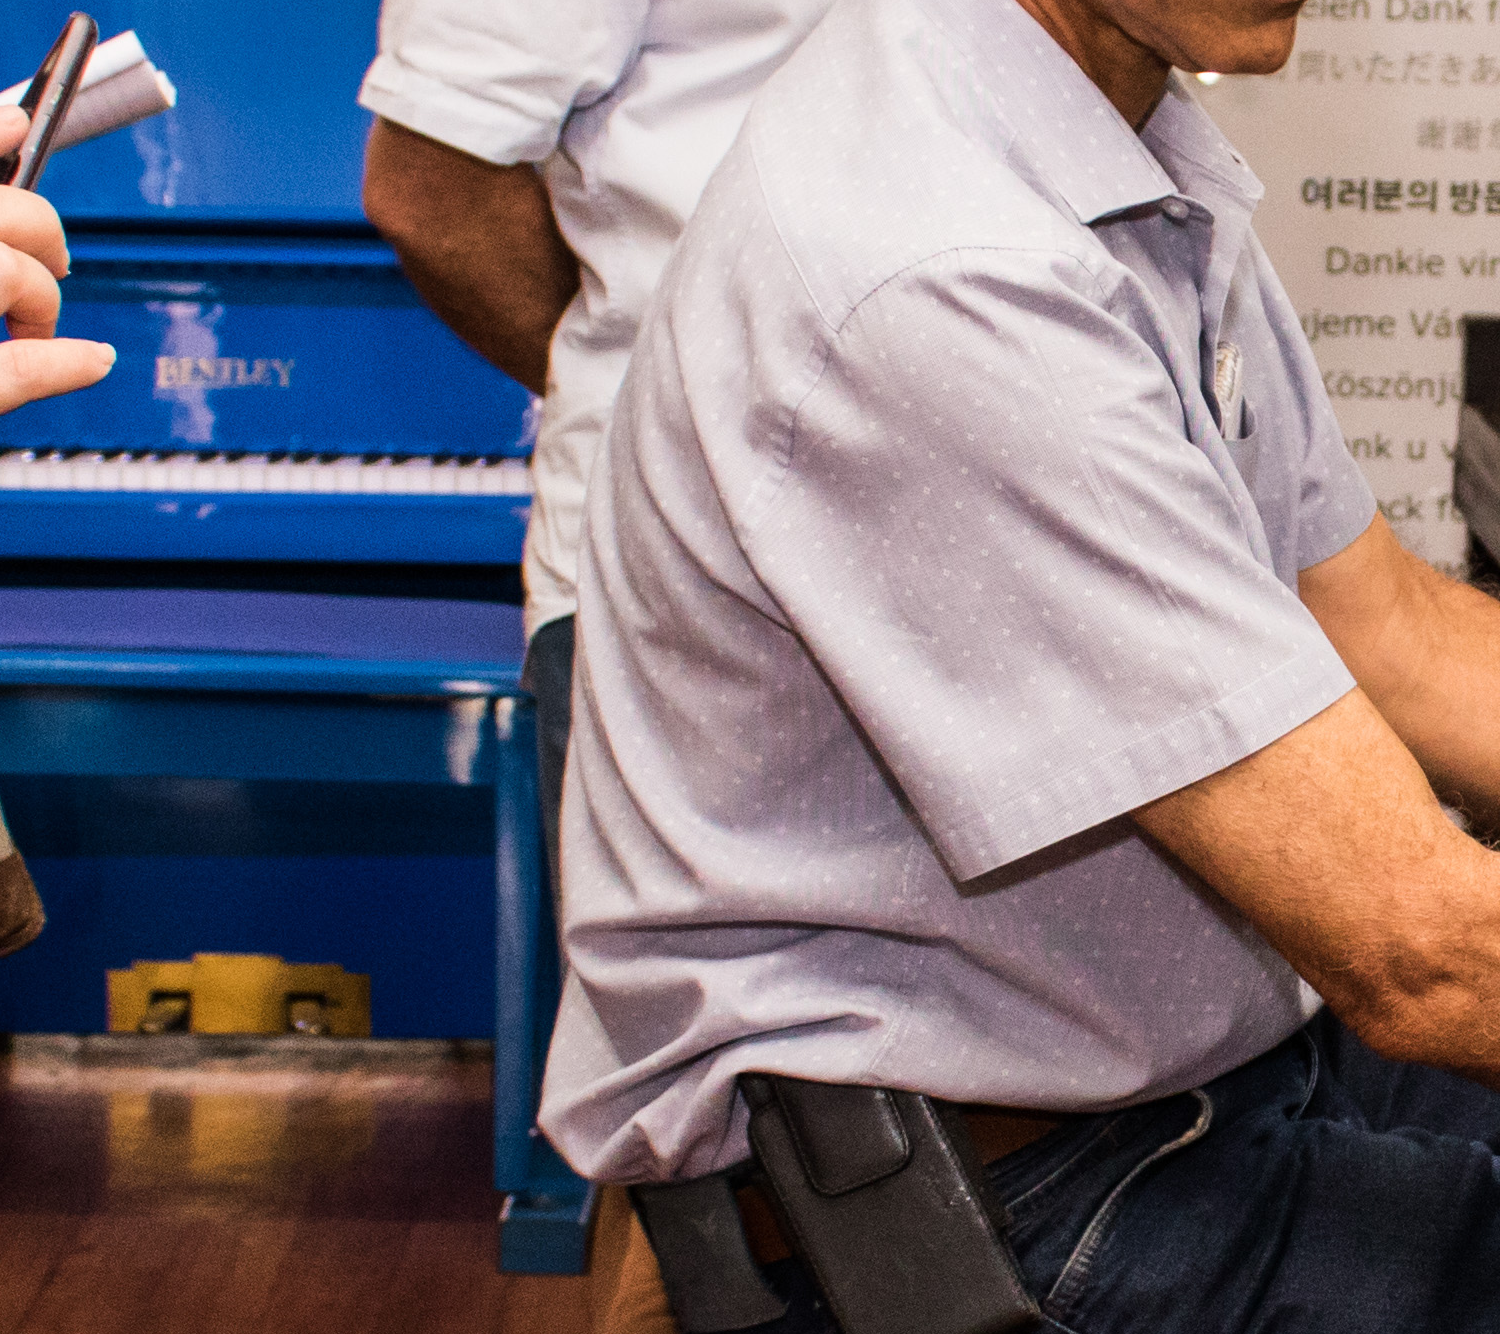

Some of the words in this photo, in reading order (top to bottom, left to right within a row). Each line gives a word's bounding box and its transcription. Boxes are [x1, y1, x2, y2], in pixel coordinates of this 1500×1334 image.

[1300, 175, 1439, 213] 여러분의
[1324, 245, 1446, 280] Dankie
[155, 355, 296, 389] BENTLEY
